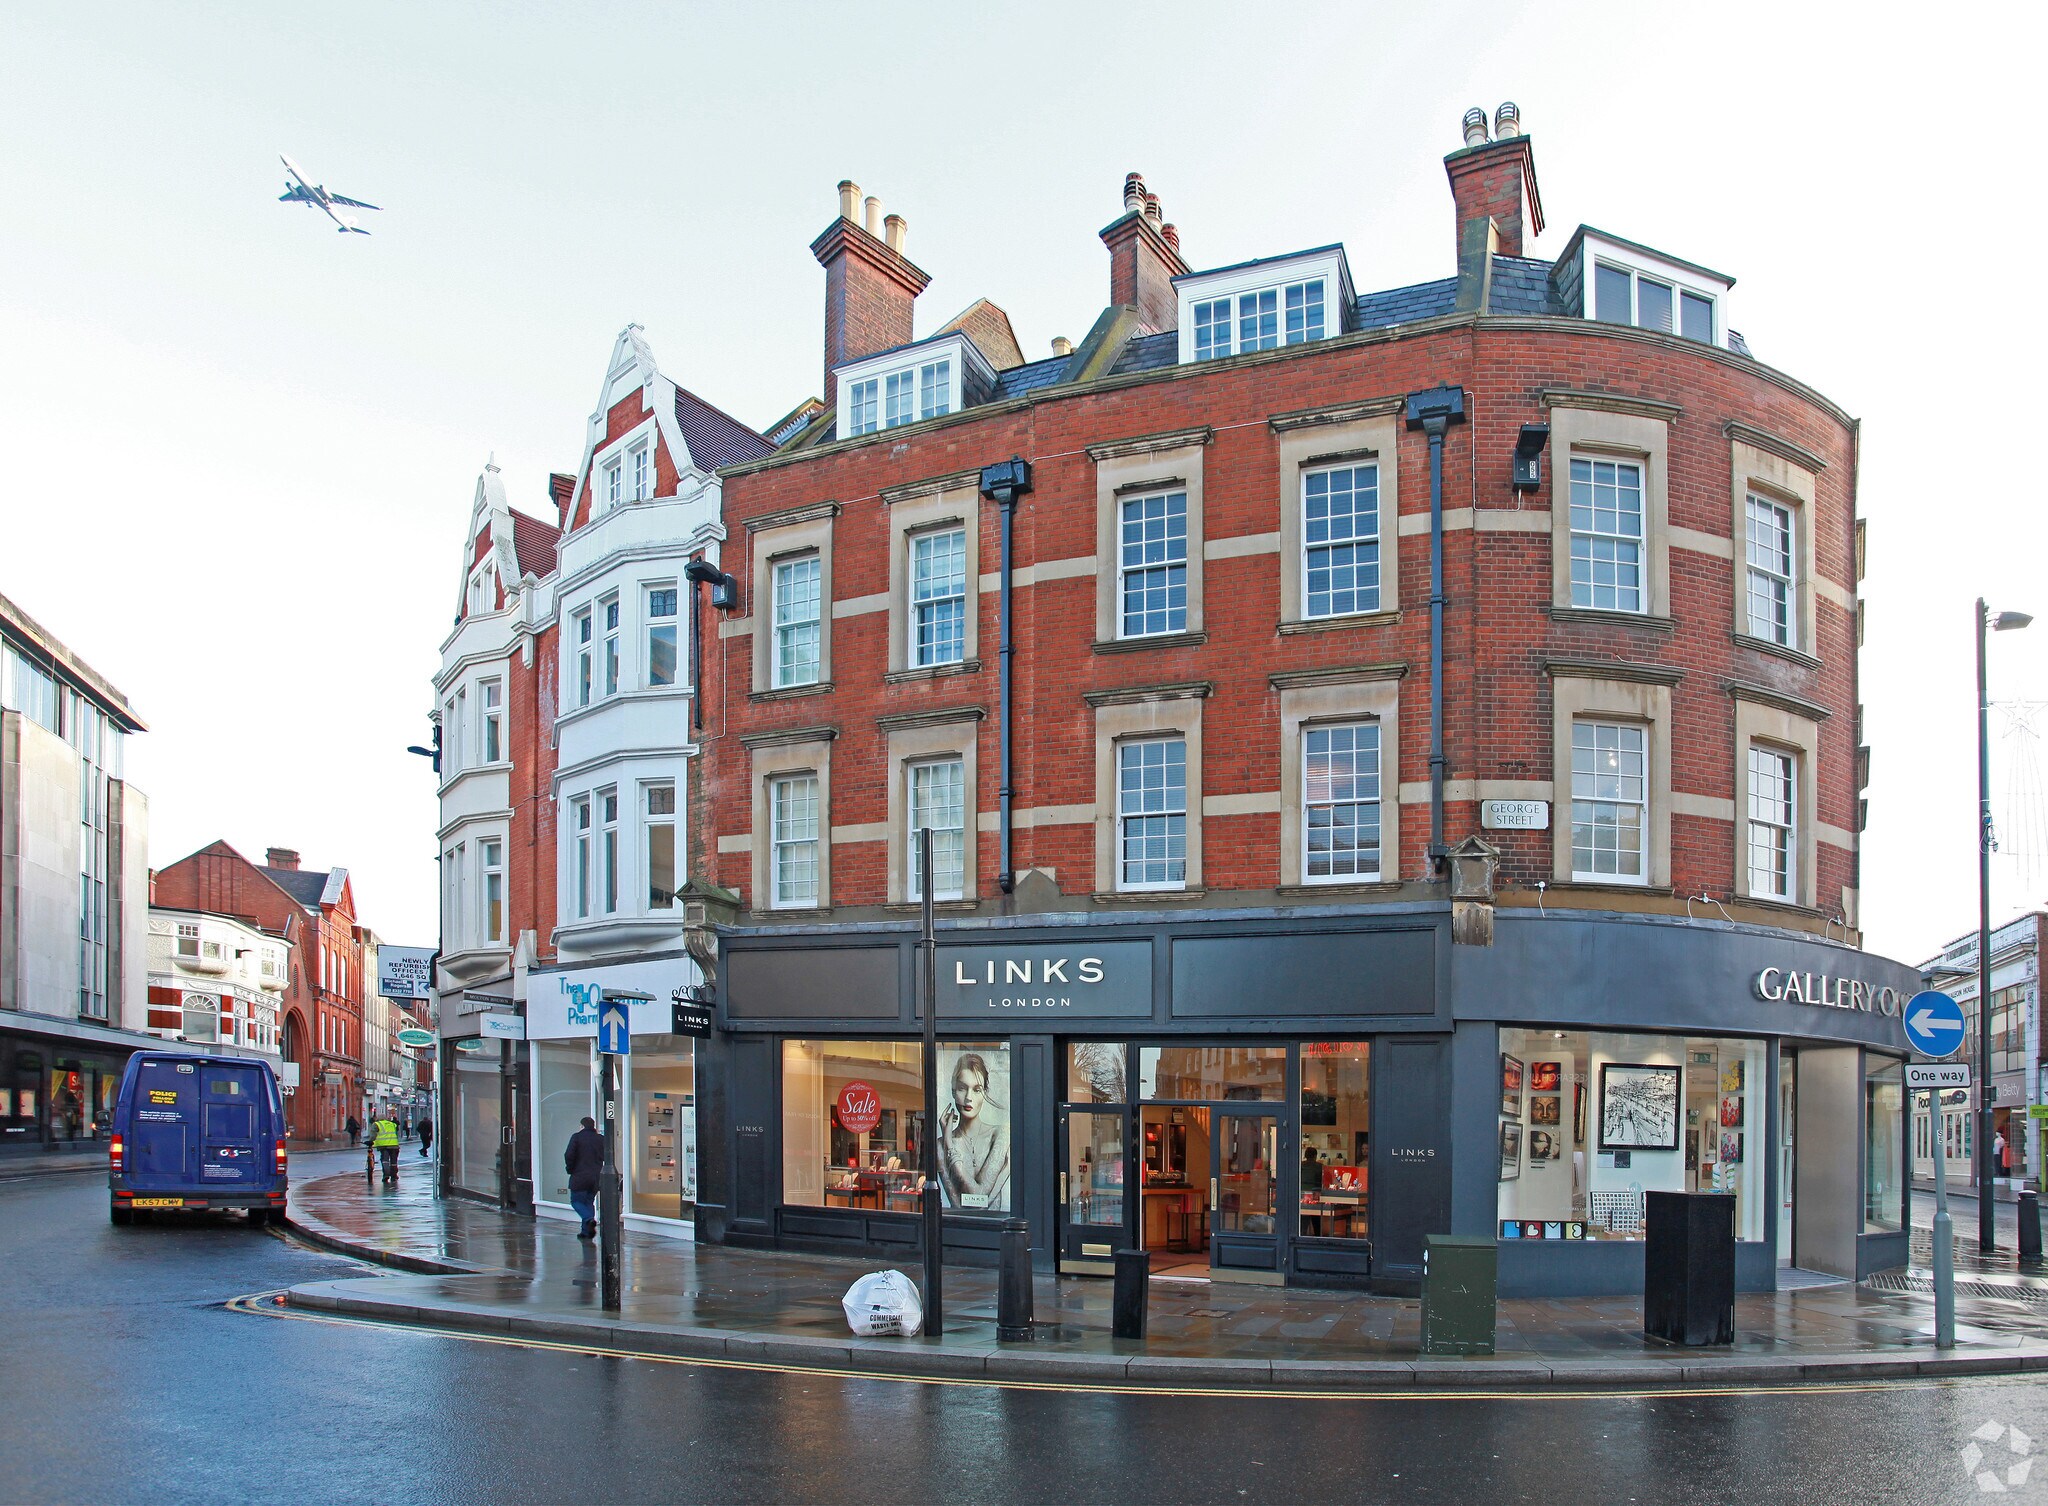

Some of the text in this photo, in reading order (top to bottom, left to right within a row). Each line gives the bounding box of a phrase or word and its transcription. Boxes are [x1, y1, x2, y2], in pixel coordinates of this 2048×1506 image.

[1490, 803, 1540, 814] GEORGE
[1496, 815, 1534, 825] STREET
[956, 957, 1105, 985] LINKS
[558, 976, 578, 995] The
[1758, 966, 1876, 1013] GALLERY
[988, 997, 1071, 1008] LONDON
[677, 1014, 709, 1025] LINKS
[1910, 1069, 1965, 1083] One way
[608, 1102, 614, 1110] S
[842, 1091, 876, 1114] Sale
[736, 1125, 764, 1133] LINKS
[219, 1147, 239, 1159] G4S
[1391, 1148, 1436, 1157] LINKS
